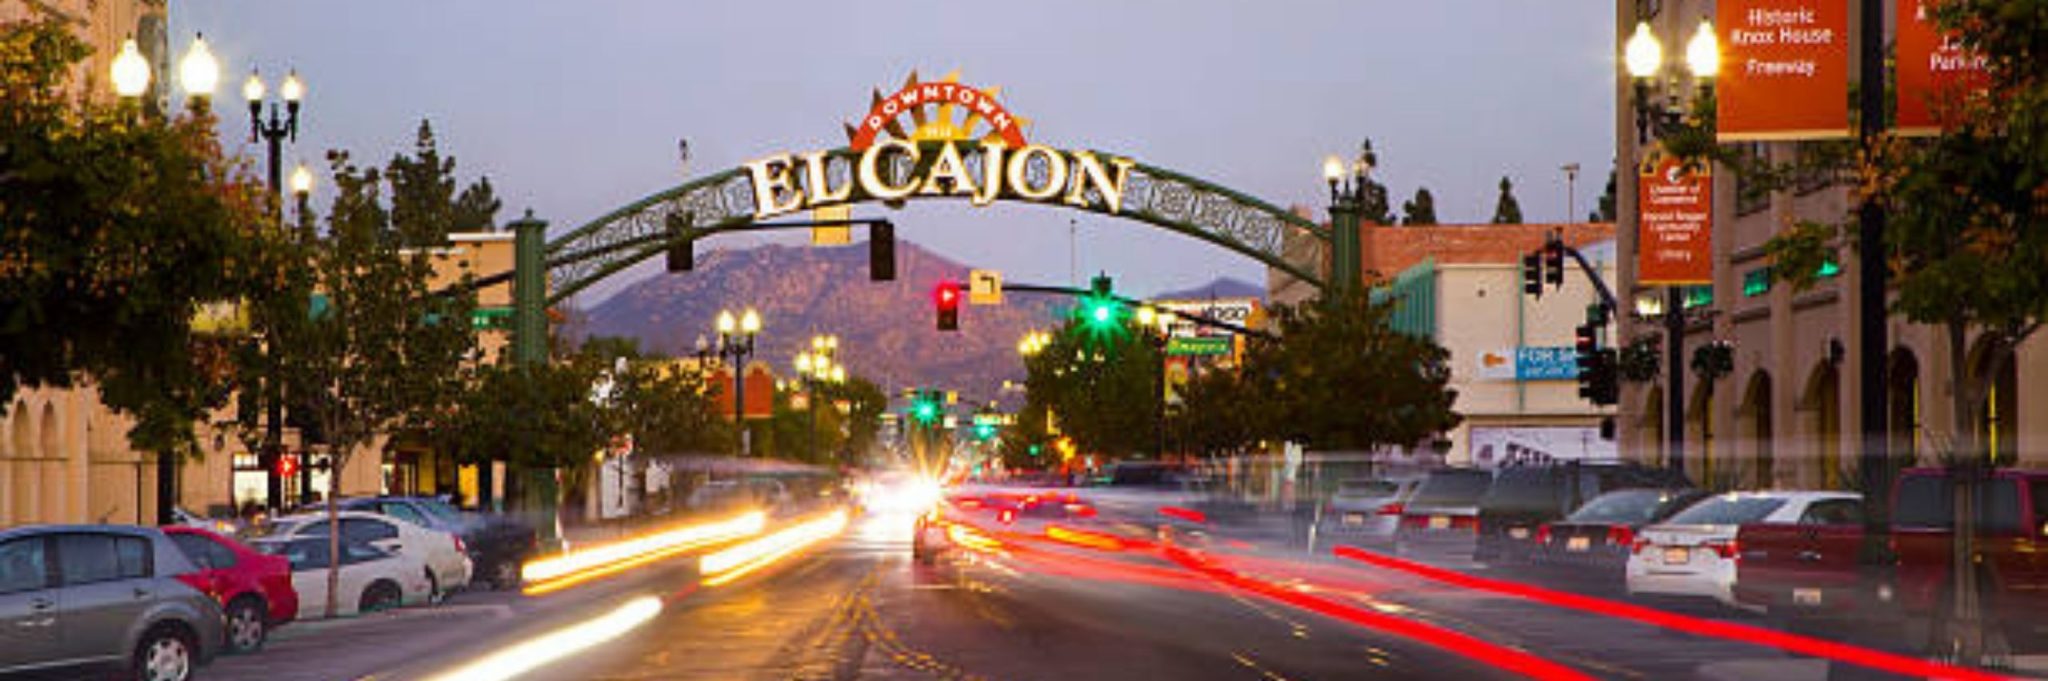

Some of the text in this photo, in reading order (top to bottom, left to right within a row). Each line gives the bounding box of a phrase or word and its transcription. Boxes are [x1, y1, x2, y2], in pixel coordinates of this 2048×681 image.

[1747, 7, 1815, 25] Historic
[1731, 27, 1832, 44] Knox House
[1746, 59, 1815, 78] Freeway
[869, 85, 1012, 131] DOWNTOWN
[746, 140, 1136, 220] EL CAJON
